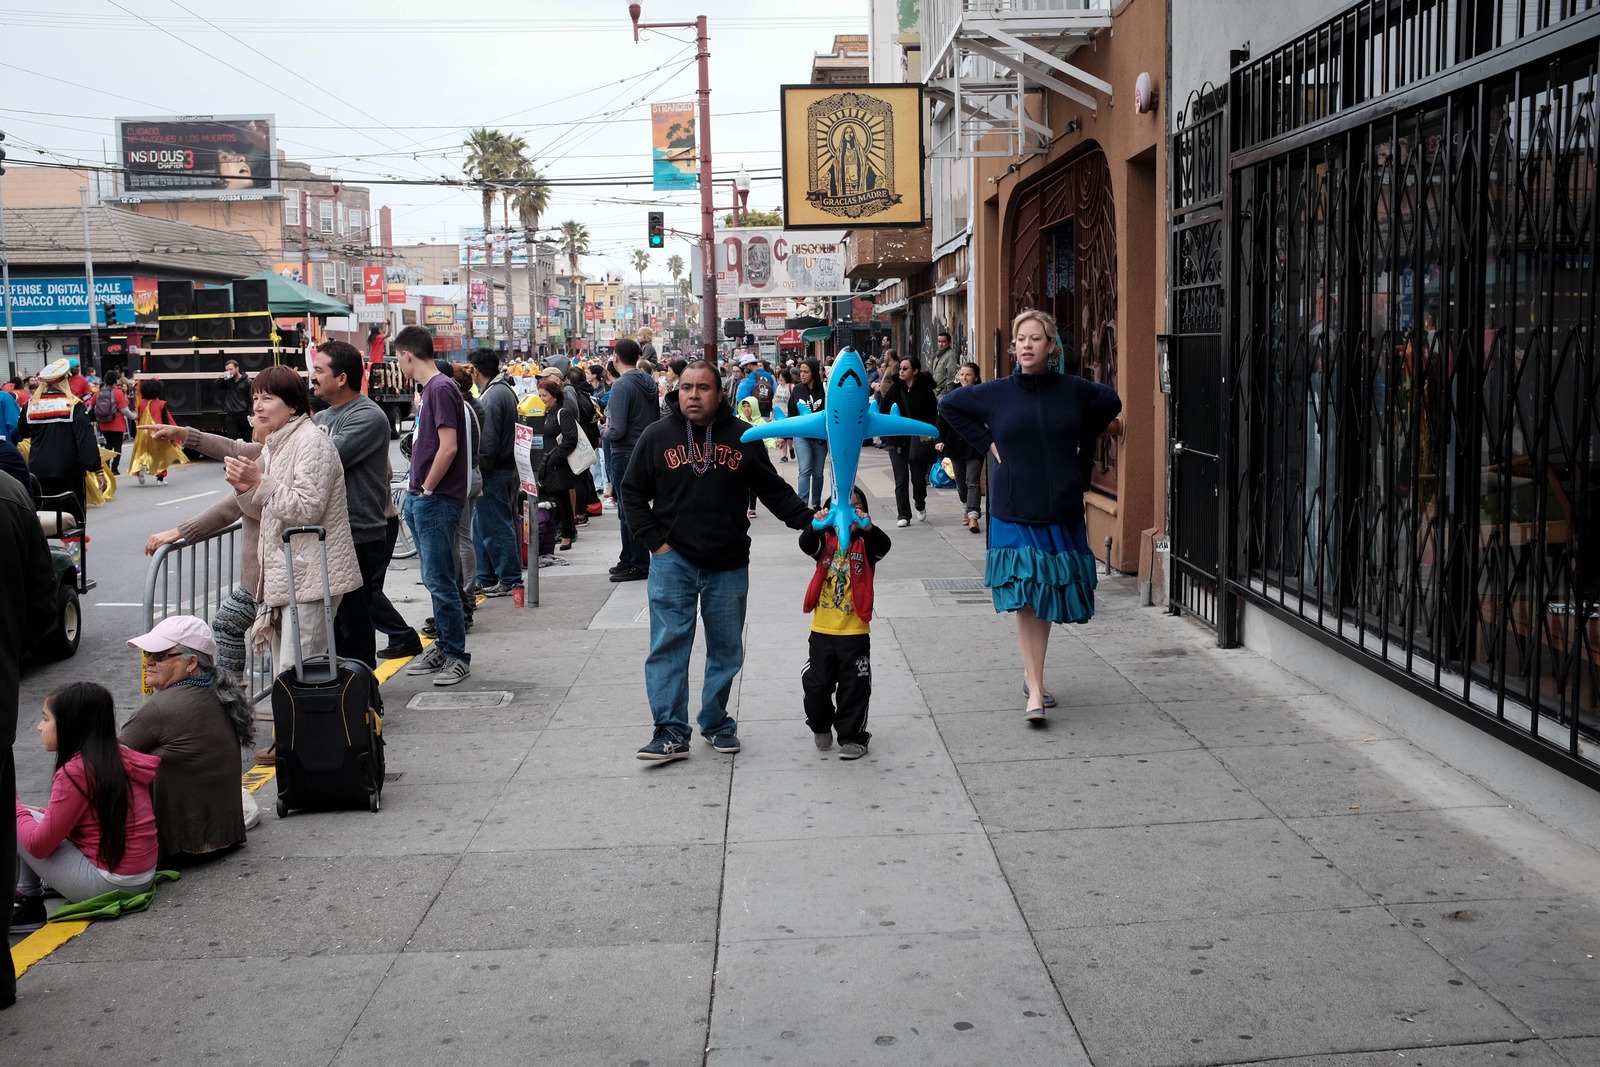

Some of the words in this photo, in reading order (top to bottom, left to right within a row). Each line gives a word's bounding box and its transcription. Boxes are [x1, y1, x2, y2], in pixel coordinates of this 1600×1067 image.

[652, 102, 693, 113] STRANDED
[128, 150, 184, 163] INSIDIOUS
[183, 149, 194, 169] 3
[823, 196, 857, 206] GRACIAS
[858, 190, 888, 203] MADRE
[791, 243, 840, 255] DISCOUNT
[47, 283, 86, 295] DIGITAL
[663, 442, 743, 470] GIANTS
[855, 562, 863, 575] 2
